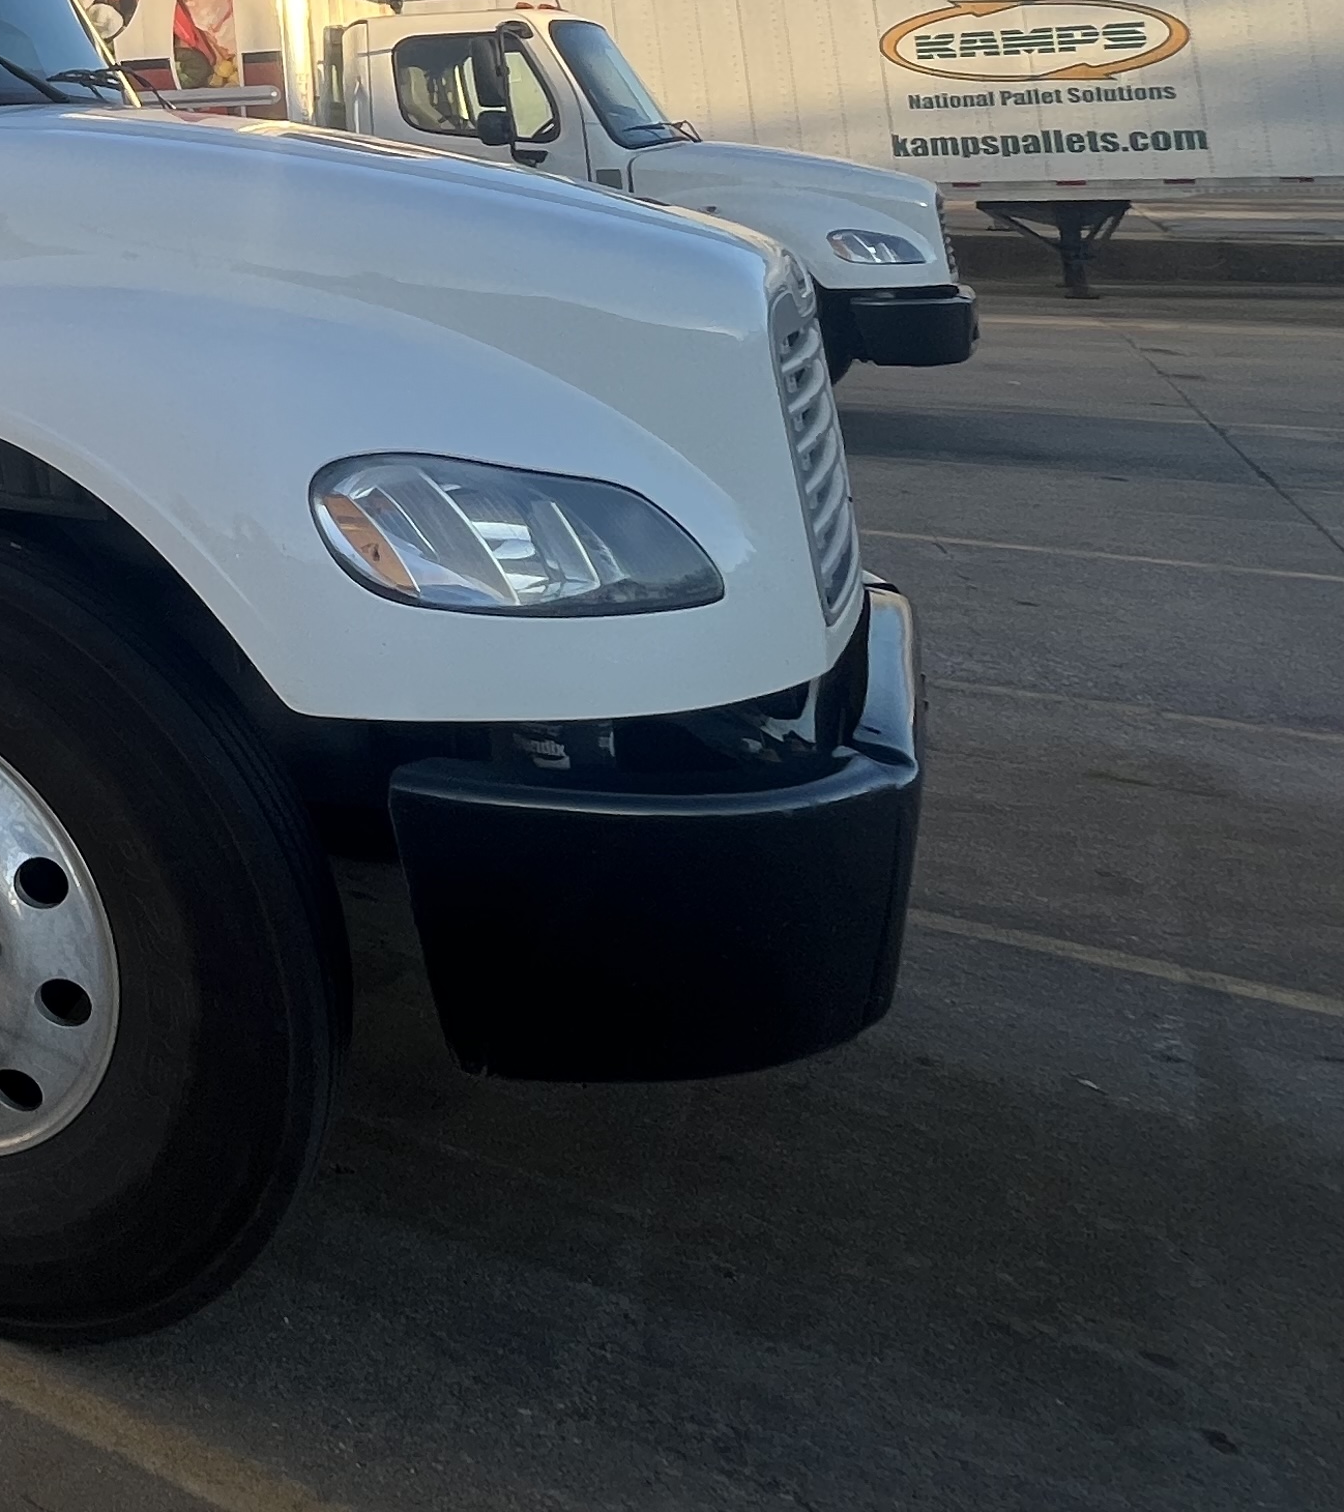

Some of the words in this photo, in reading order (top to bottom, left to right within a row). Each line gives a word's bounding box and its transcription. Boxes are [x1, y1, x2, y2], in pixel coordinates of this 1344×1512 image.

[914, 21, 1148, 60] KAMPS
[908, 90, 994, 110] National
[1001, 88, 1062, 106] Pallet
[1067, 85, 1177, 104] Solutions
[891, 129, 1208, 158] kampspallets.com
